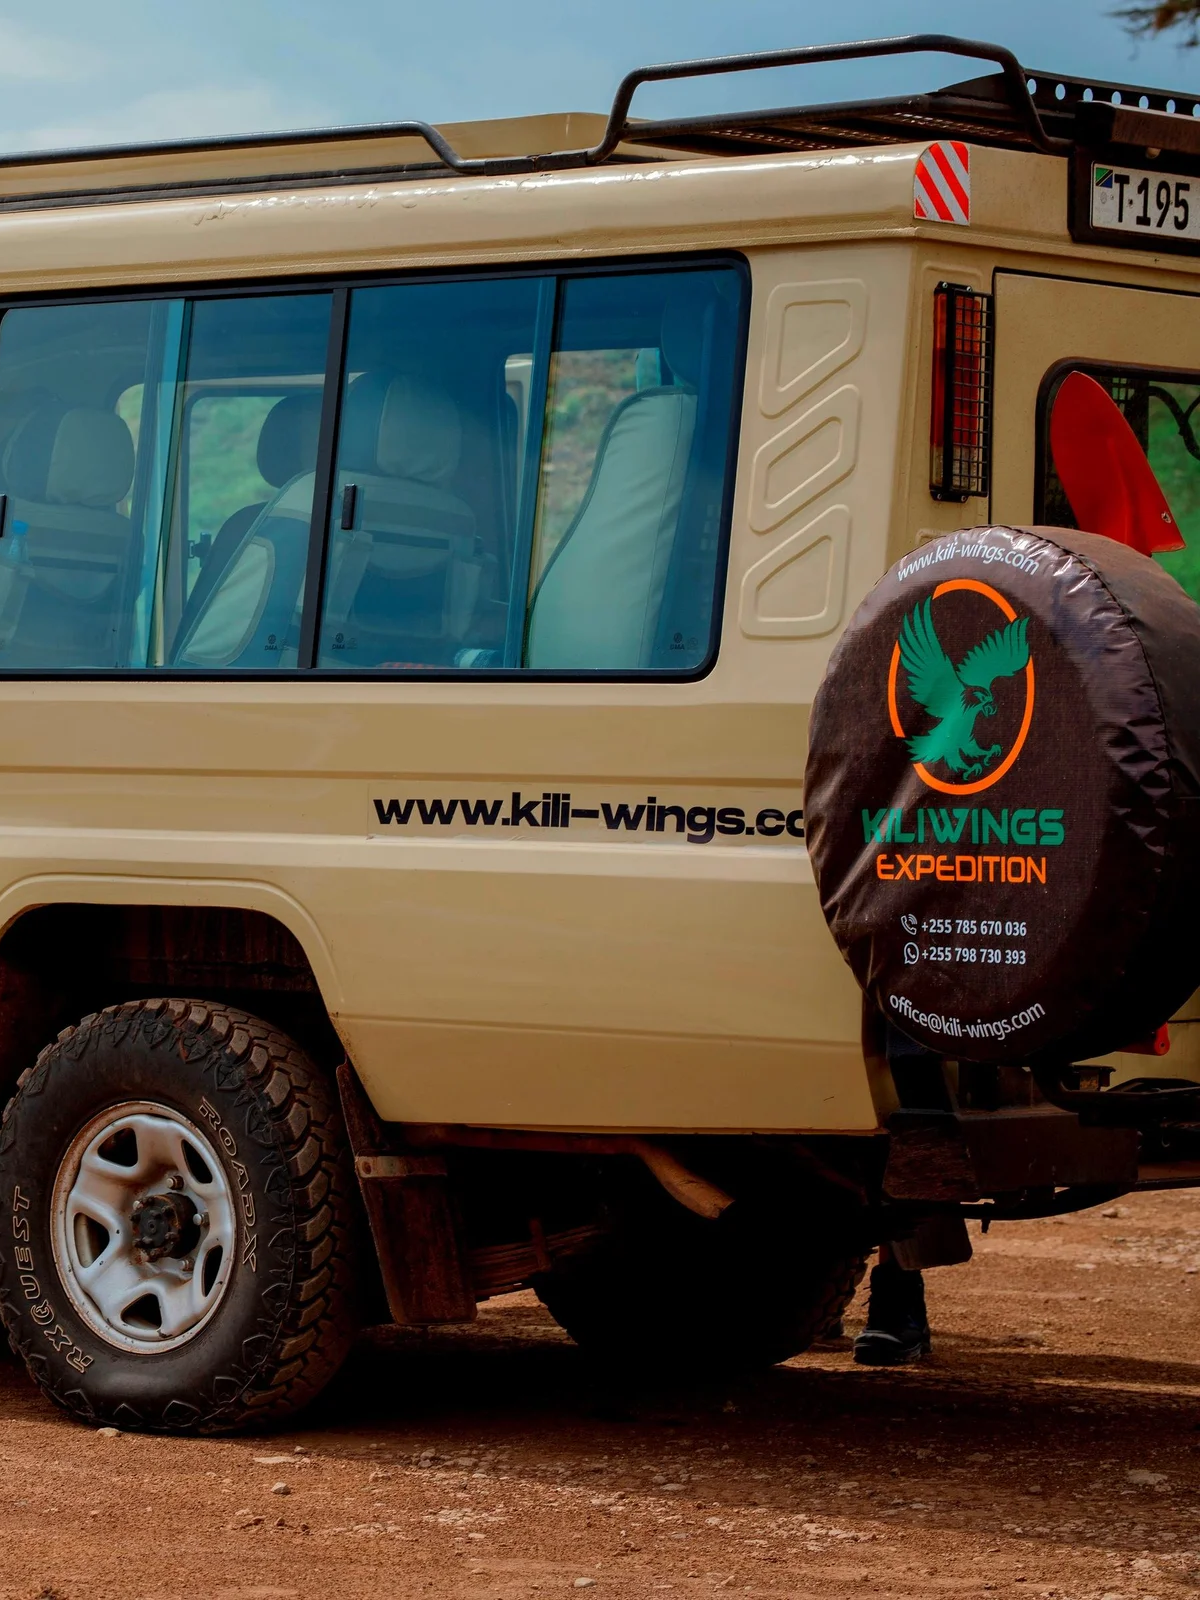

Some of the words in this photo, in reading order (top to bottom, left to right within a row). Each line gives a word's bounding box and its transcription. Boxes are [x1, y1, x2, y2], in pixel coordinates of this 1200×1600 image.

[898, 543, 1040, 581] www.kili-wings.com
[861, 807, 1065, 846] KILIWINGS
[876, 853, 1047, 884] EXPEDITION
[921, 918, 952, 934] +255
[955, 919, 977, 935] 785
[980, 920, 1002, 935] 670
[1005, 921, 1027, 937] 036
[921, 946, 952, 962] +255
[954, 947, 977, 963] 798
[979, 948, 1002, 964] 730
[1005, 949, 1026, 965] 393
[889, 994, 1046, 1041] office@kili-wings.com
[198, 1095, 259, 1274] ROADX
